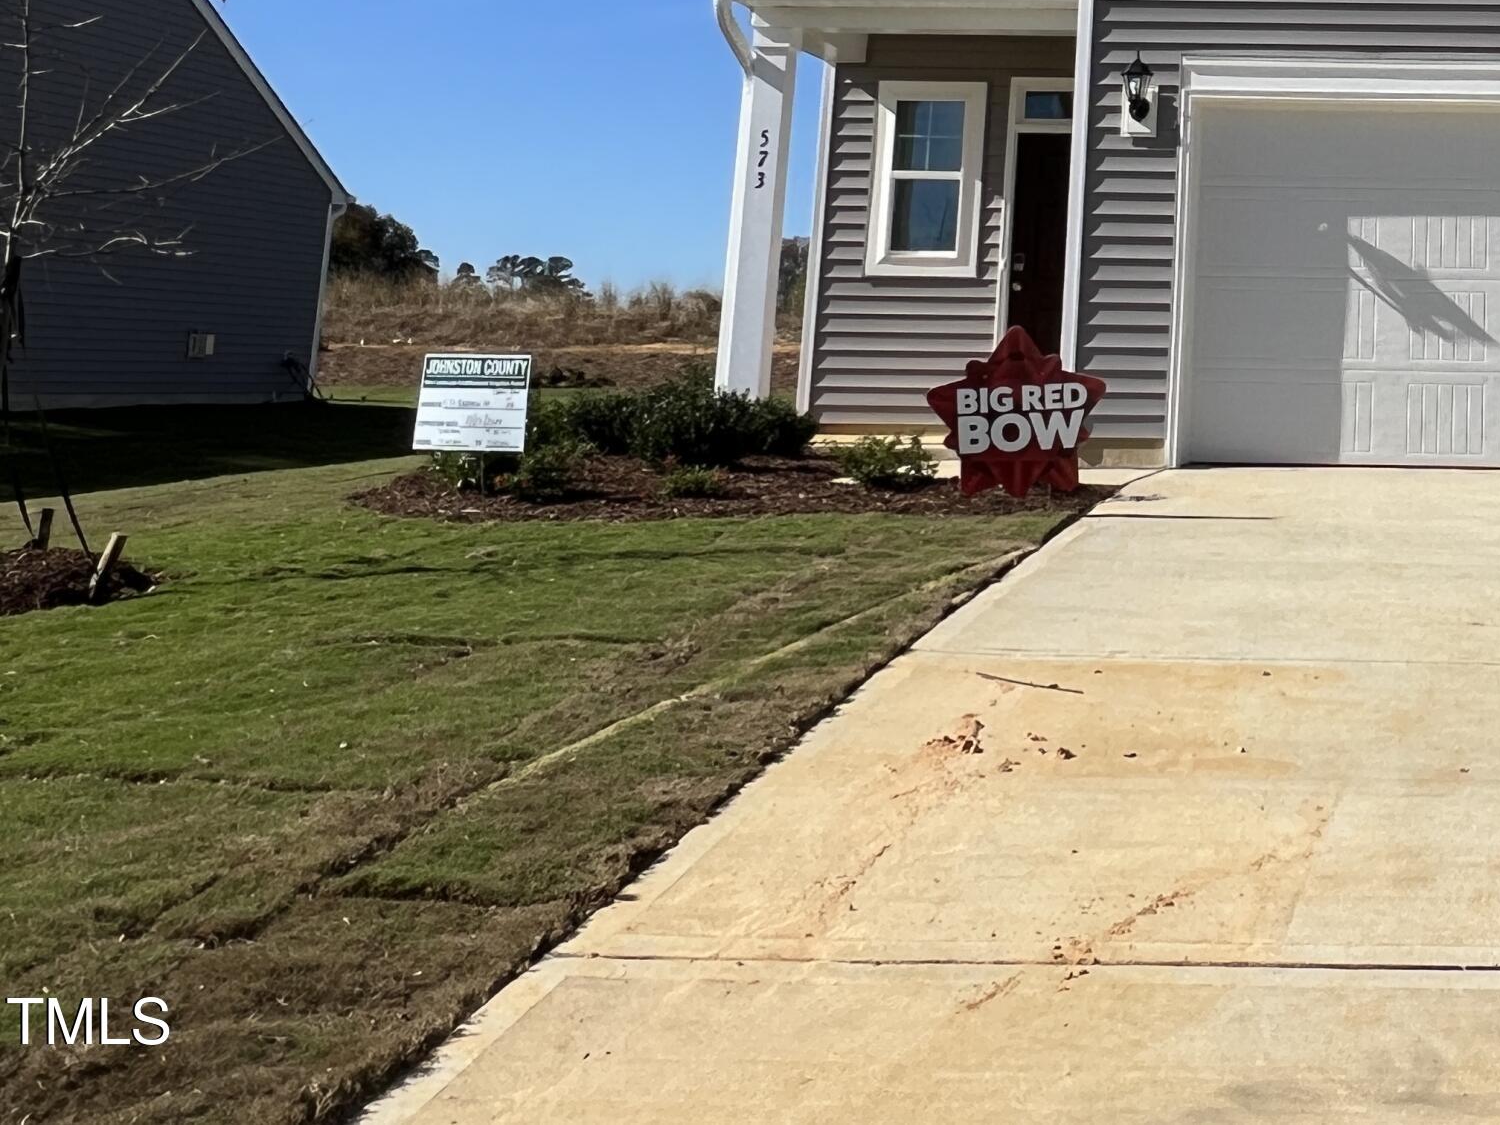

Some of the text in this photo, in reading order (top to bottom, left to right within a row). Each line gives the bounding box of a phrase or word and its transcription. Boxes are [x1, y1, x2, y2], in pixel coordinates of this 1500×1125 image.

[754, 129, 769, 189] 573
[426, 359, 528, 376] JOHNSTON COUNTY
[956, 382, 1088, 415] BIG RED
[957, 409, 1085, 455] BOW
